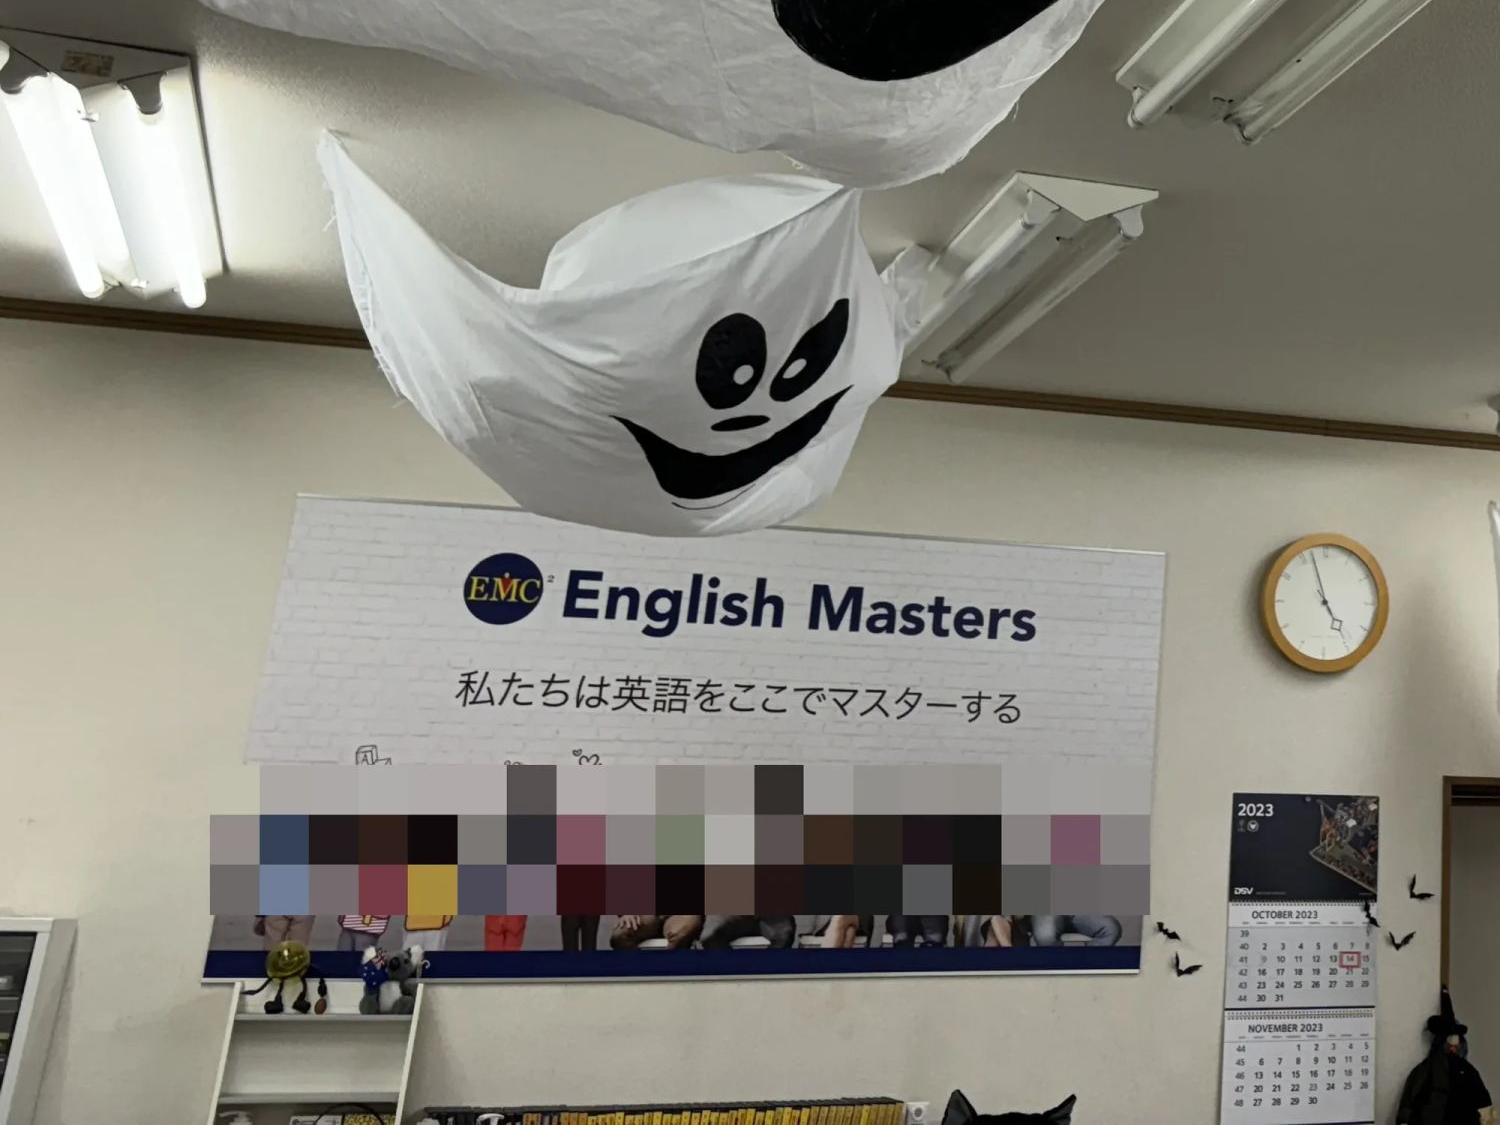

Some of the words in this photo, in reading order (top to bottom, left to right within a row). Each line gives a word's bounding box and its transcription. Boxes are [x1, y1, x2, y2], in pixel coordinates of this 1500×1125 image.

[467, 575, 542, 604] EMC
[563, 570, 785, 638] English
[808, 584, 1036, 642] Masters
[456, 670, 1021, 724] 私たちは英語をここでマスターする
[1238, 803, 1274, 817] 2023
[1234, 887, 1254, 895] DSV
[1251, 910, 1294, 920] OCTOBER
[1295, 910, 1318, 919] 2023
[1239, 929, 1250, 938] 39
[1239, 942, 1249, 951] 40
[1262, 942, 1268, 951] 2
[1280, 942, 1286, 951] 3
[1298, 942, 1304, 950] 4
[1316, 942, 1321, 950] 5
[1332, 942, 1338, 950] 6
[1349, 942, 1355, 950] 7
[1238, 956, 1248, 964] 41
[1276, 955, 1286, 964] 10
[1294, 955, 1303, 964] 11
[1312, 955, 1321, 964] 12
[1329, 955, 1338, 963] 13
[1346, 955, 1355, 963] 14
[1238, 968, 1248, 977] 42
[1257, 968, 1267, 977] 16
[1276, 968, 1285, 976] 17
[1294, 968, 1303, 976] 18
[1312, 968, 1321, 976] 19
[1328, 968, 1338, 976] 20
[1238, 981, 1248, 990] 43
[1256, 981, 1267, 989] 23
[1275, 981, 1285, 989] 24
[1293, 981, 1303, 989] 25
[1311, 980, 1321, 989] 26
[1328, 980, 1337, 988] 27
[1237, 994, 1248, 1003] 44
[1256, 994, 1267, 1003] 30
[1275, 994, 1284, 1002] 31
[1248, 1024, 1298, 1033] NOVEMBER
[1300, 1023, 1323, 1032] 2023
[1236, 1045, 1246, 1053] 44
[1314, 1043, 1319, 1051] 2
[1331, 1043, 1336, 1051] 3
[1348, 1042, 1354, 1050] 4
[1364, 1042, 1369, 1050] 5
[1235, 1058, 1245, 1066] 45
[1258, 1058, 1265, 1066] 6
[1296, 1057, 1301, 1065] 8
[1313, 1057, 1319, 1065] 9
[1327, 1056, 1337, 1064] 10
[1360, 1055, 1369, 1063] 12
[1234, 1072, 1245, 1080] 46
[1254, 1071, 1264, 1079] 13
[1273, 1071, 1282, 1079] 14
[1309, 1070, 1319, 1078] 16
[1360, 1068, 1369, 1076] 19
[1234, 1085, 1244, 1093] 47
[1253, 1085, 1264, 1093] 20
[1272, 1084, 1281, 1092] 21
[1290, 1084, 1300, 1092] 22
[1308, 1083, 1318, 1091] 23
[1326, 1083, 1336, 1091] 24
[1343, 1082, 1352, 1090] 25
[1234, 1099, 1244, 1107] 48
[1252, 1098, 1263, 1107] 27
[1271, 1098, 1282, 1106] 28
[1290, 1097, 1300, 1106] 29
[1308, 1097, 1318, 1105] 30
